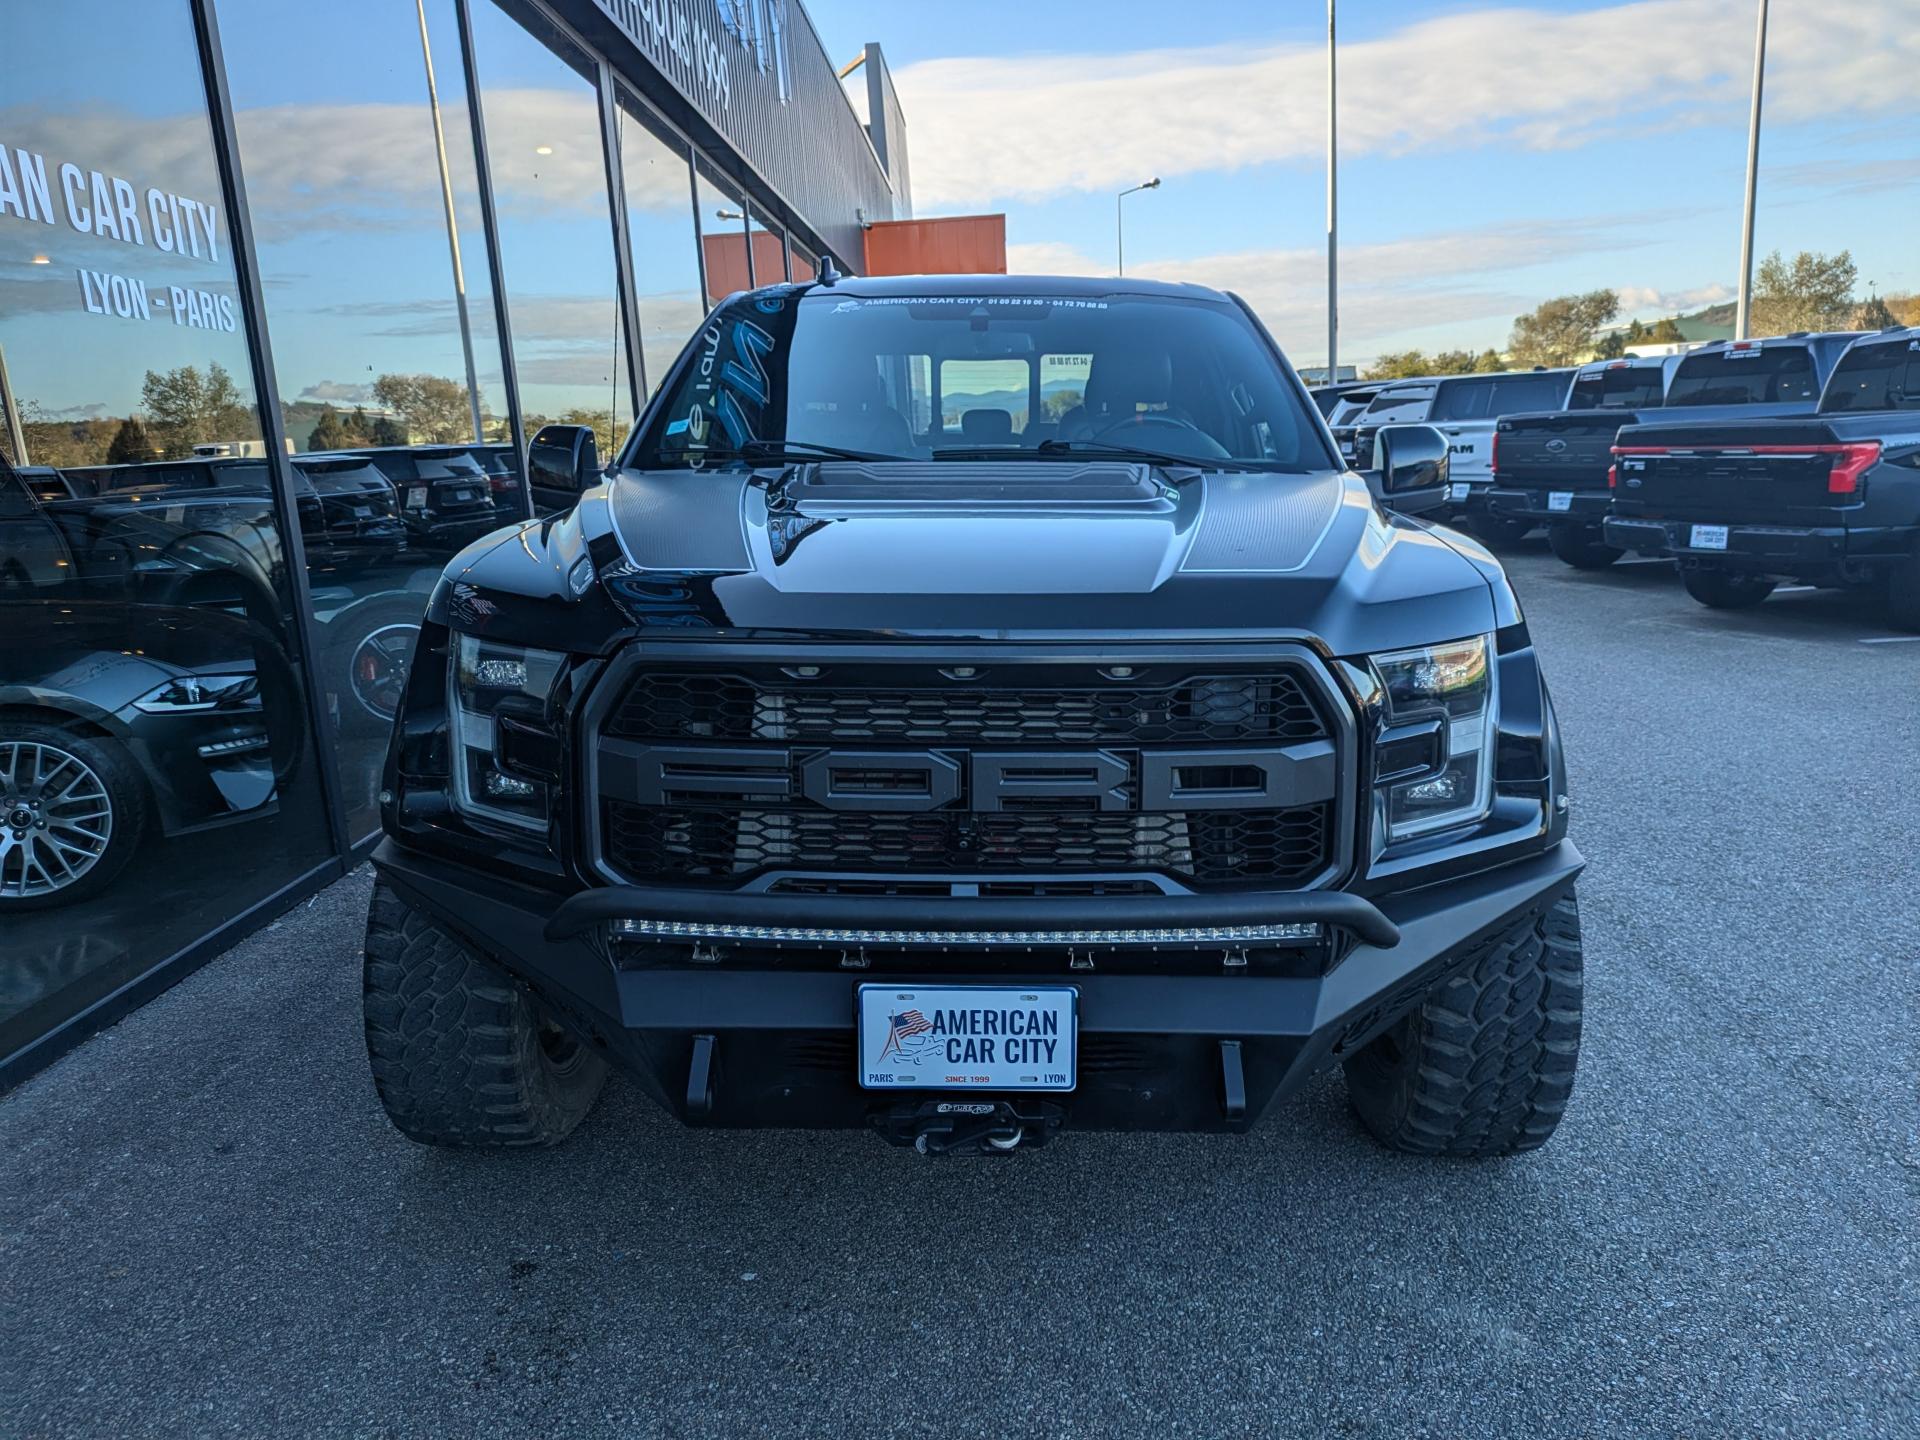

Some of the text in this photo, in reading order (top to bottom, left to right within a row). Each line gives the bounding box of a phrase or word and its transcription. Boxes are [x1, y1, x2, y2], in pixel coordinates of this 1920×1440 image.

[694, 18, 729, 110] 1999
[60, 163, 144, 245] CAR
[147, 188, 219, 262] CITY
[78, 269, 236, 333] LYON - PARIS
[865, 297, 927, 305] AMERICAN
[929, 297, 954, 305] CAR
[957, 297, 984, 305] CITY
[1447, 445, 1473, 453] AM
[612, 742, 1326, 812] FORD
[931, 1009, 1058, 1035] AMERICAN
[946, 1038, 1058, 1064] CAR CITY
[869, 1073, 894, 1083] PARIS
[1044, 1073, 1066, 1084] LYON
